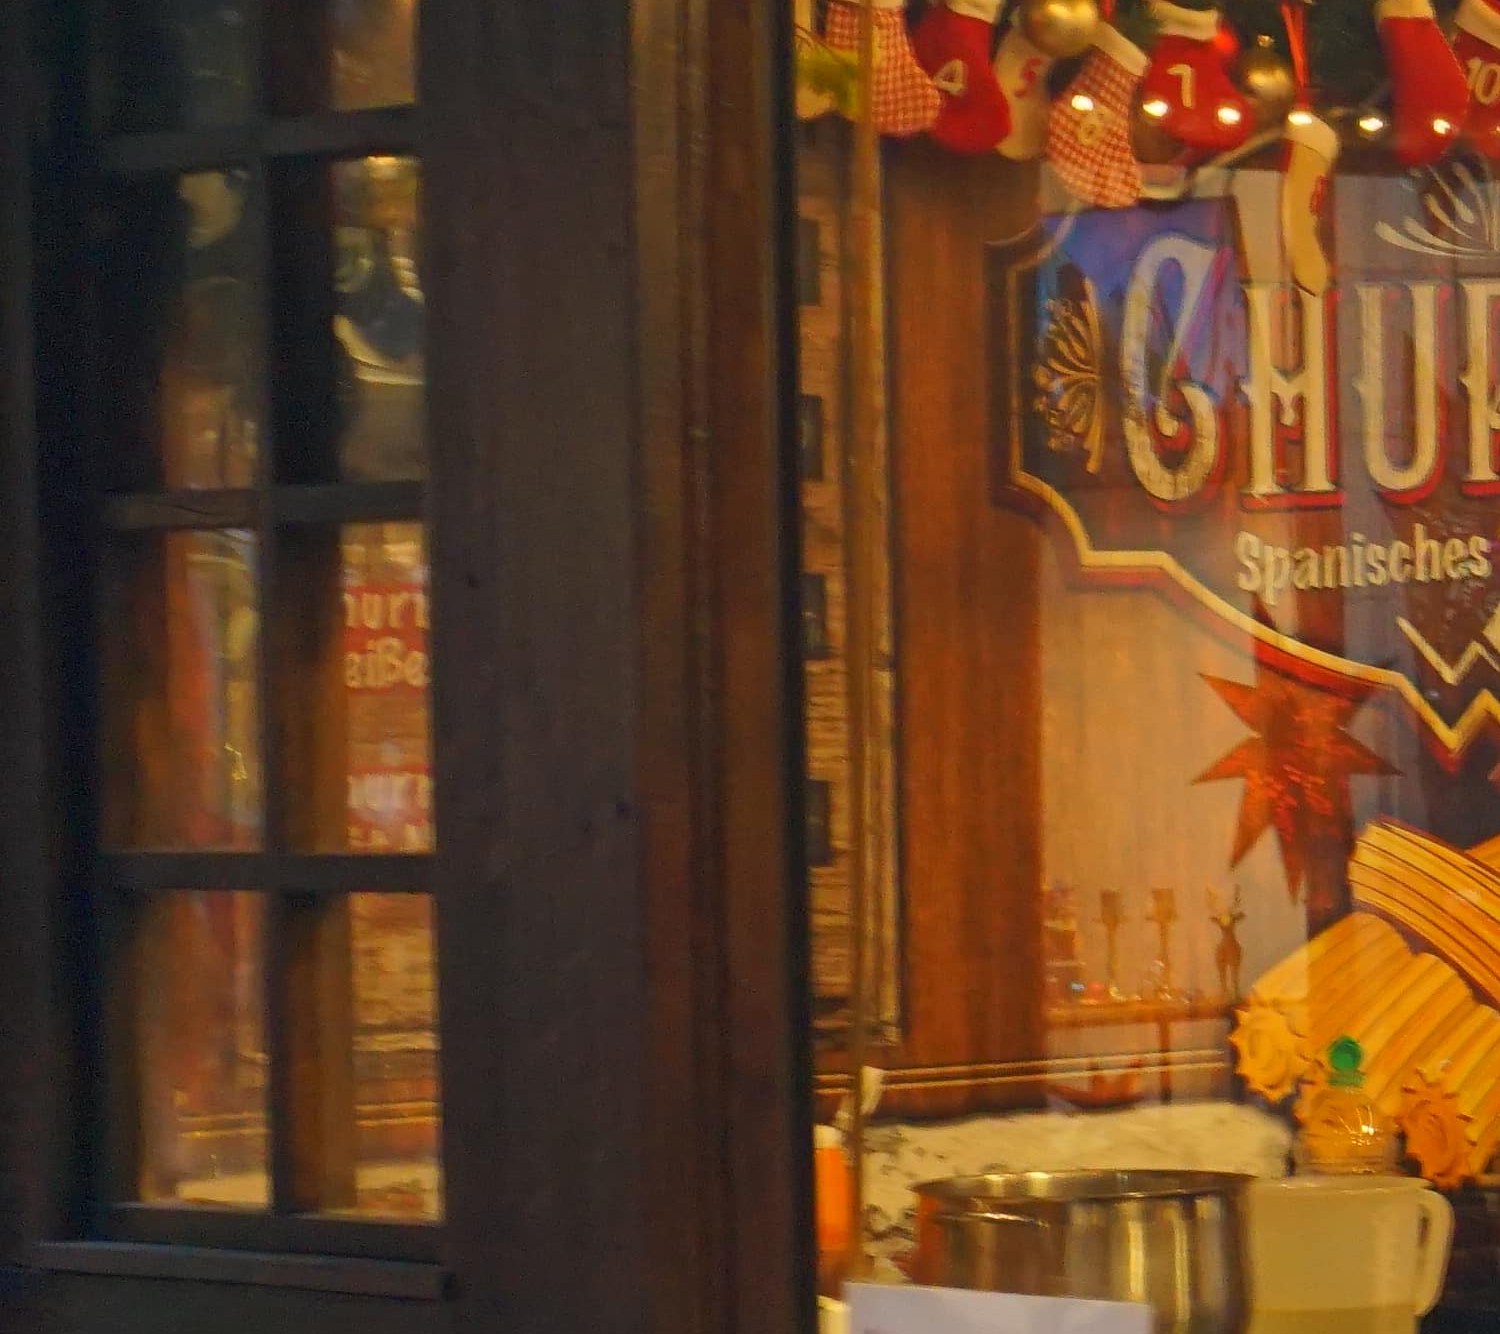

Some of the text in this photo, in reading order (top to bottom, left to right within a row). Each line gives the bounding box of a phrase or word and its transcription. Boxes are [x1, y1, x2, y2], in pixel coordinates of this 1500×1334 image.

[934, 58, 969, 96] 4
[1166, 63, 1194, 108] 7
[1234, 520, 1493, 596] Spanisches
